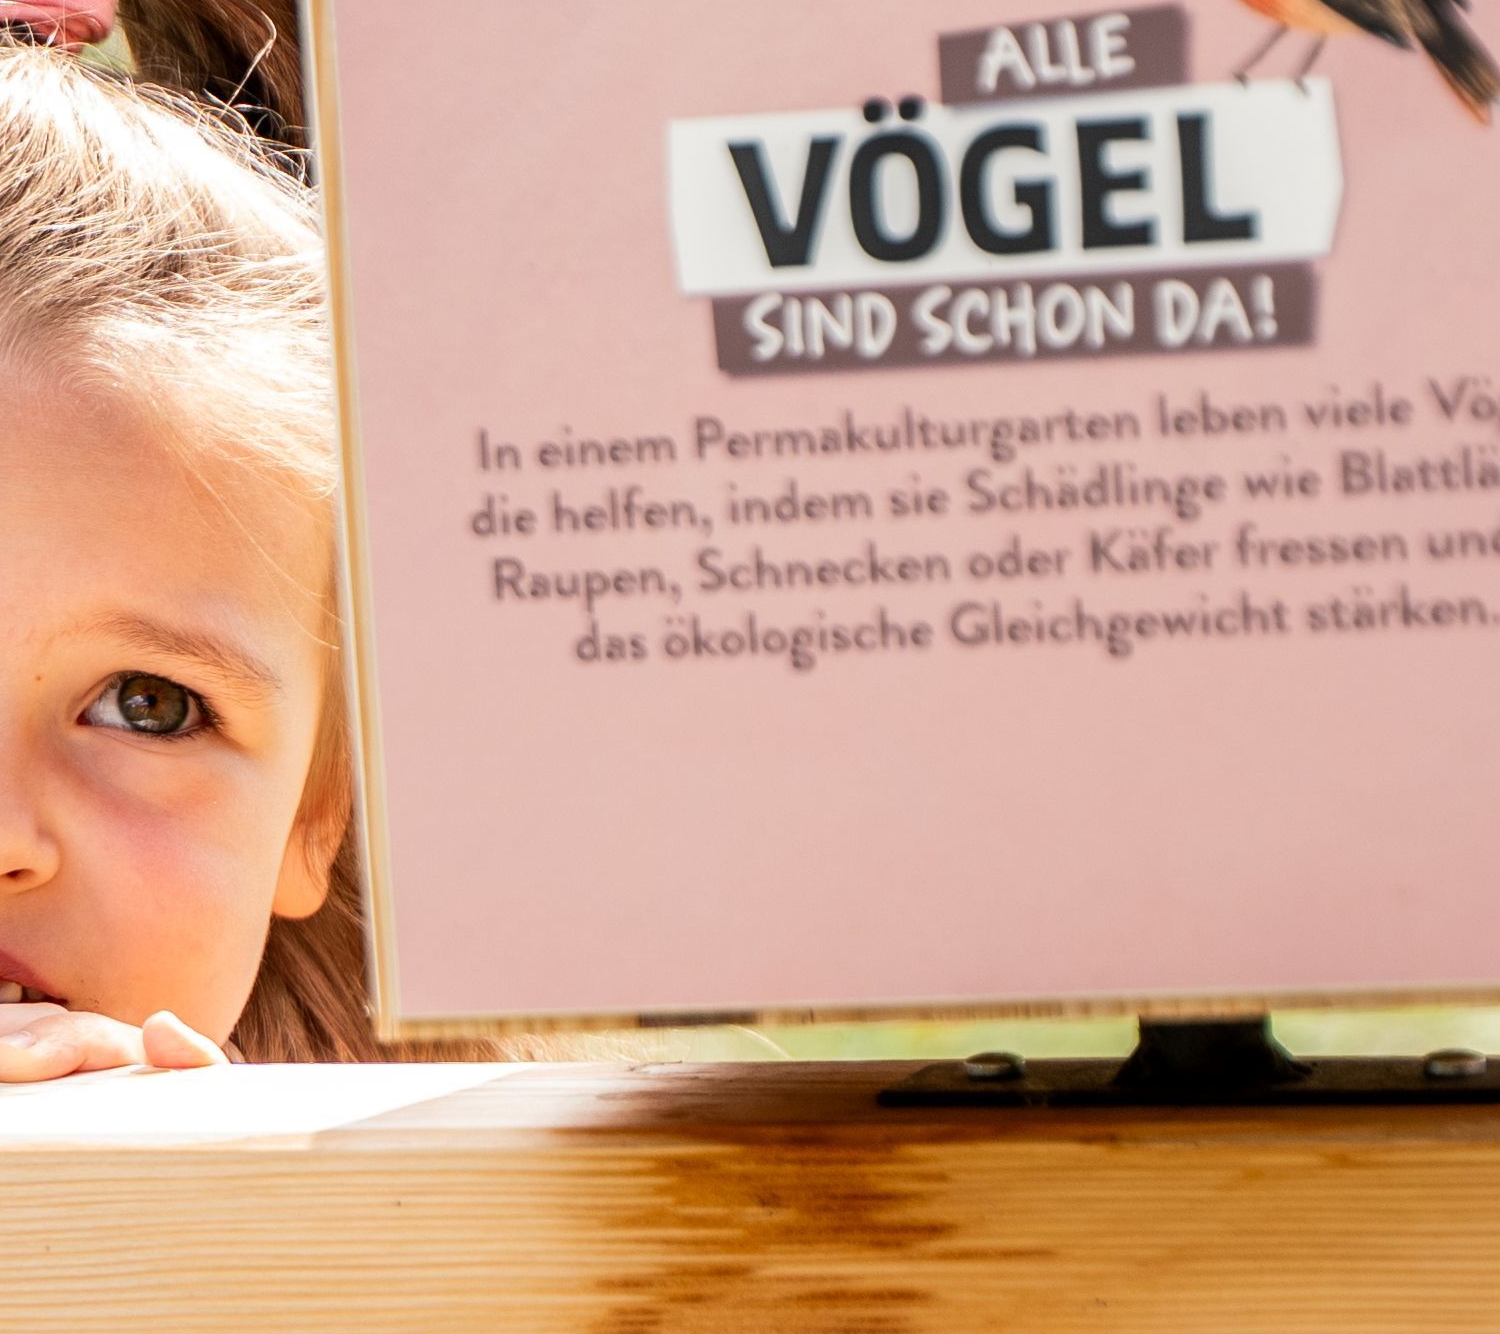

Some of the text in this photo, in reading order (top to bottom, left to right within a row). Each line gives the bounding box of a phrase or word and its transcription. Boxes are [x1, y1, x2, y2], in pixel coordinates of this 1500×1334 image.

[978, 15, 1133, 92] ALLE
[727, 95, 1257, 269] VÖGEL
[744, 276, 1276, 360] SIND SCHON DA!
[478, 428, 522, 471] In
[538, 427, 677, 466] einem
[695, 405, 1141, 463] Permakulturgarten
[1157, 389, 1287, 438] leben
[1303, 381, 1413, 428] viele
[472, 494, 537, 538] die
[553, 486, 713, 538] helfen,
[727, 479, 872, 525] indem
[888, 472, 949, 516] sie
[966, 464, 1226, 520] Schädlinge
[1244, 456, 1321, 498] wie
[493, 556, 683, 613] Raupen,
[697, 541, 952, 592] Schnecken
[968, 536, 1071, 579] oder
[1089, 527, 1219, 573] Käfer
[1236, 522, 1408, 565] fressen
[576, 581, 1500, 672] das ökologische Gleichgewicht stärken.
